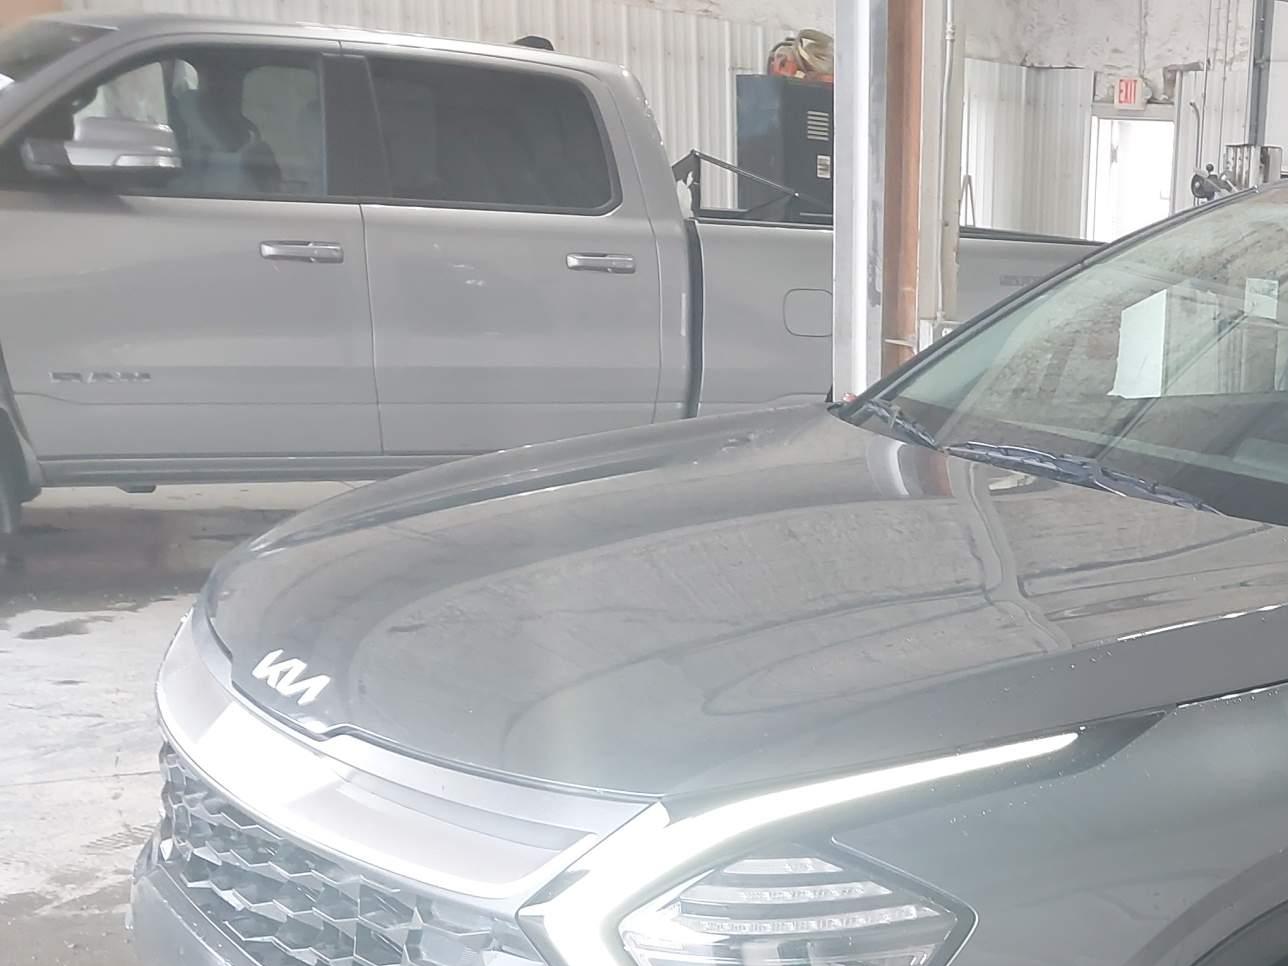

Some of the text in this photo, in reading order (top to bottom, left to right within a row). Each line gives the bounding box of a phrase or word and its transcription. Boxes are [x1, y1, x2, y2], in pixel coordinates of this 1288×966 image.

[1118, 79, 1138, 104] EXIT
[47, 370, 153, 384] RAM
[252, 648, 332, 706] KIA
